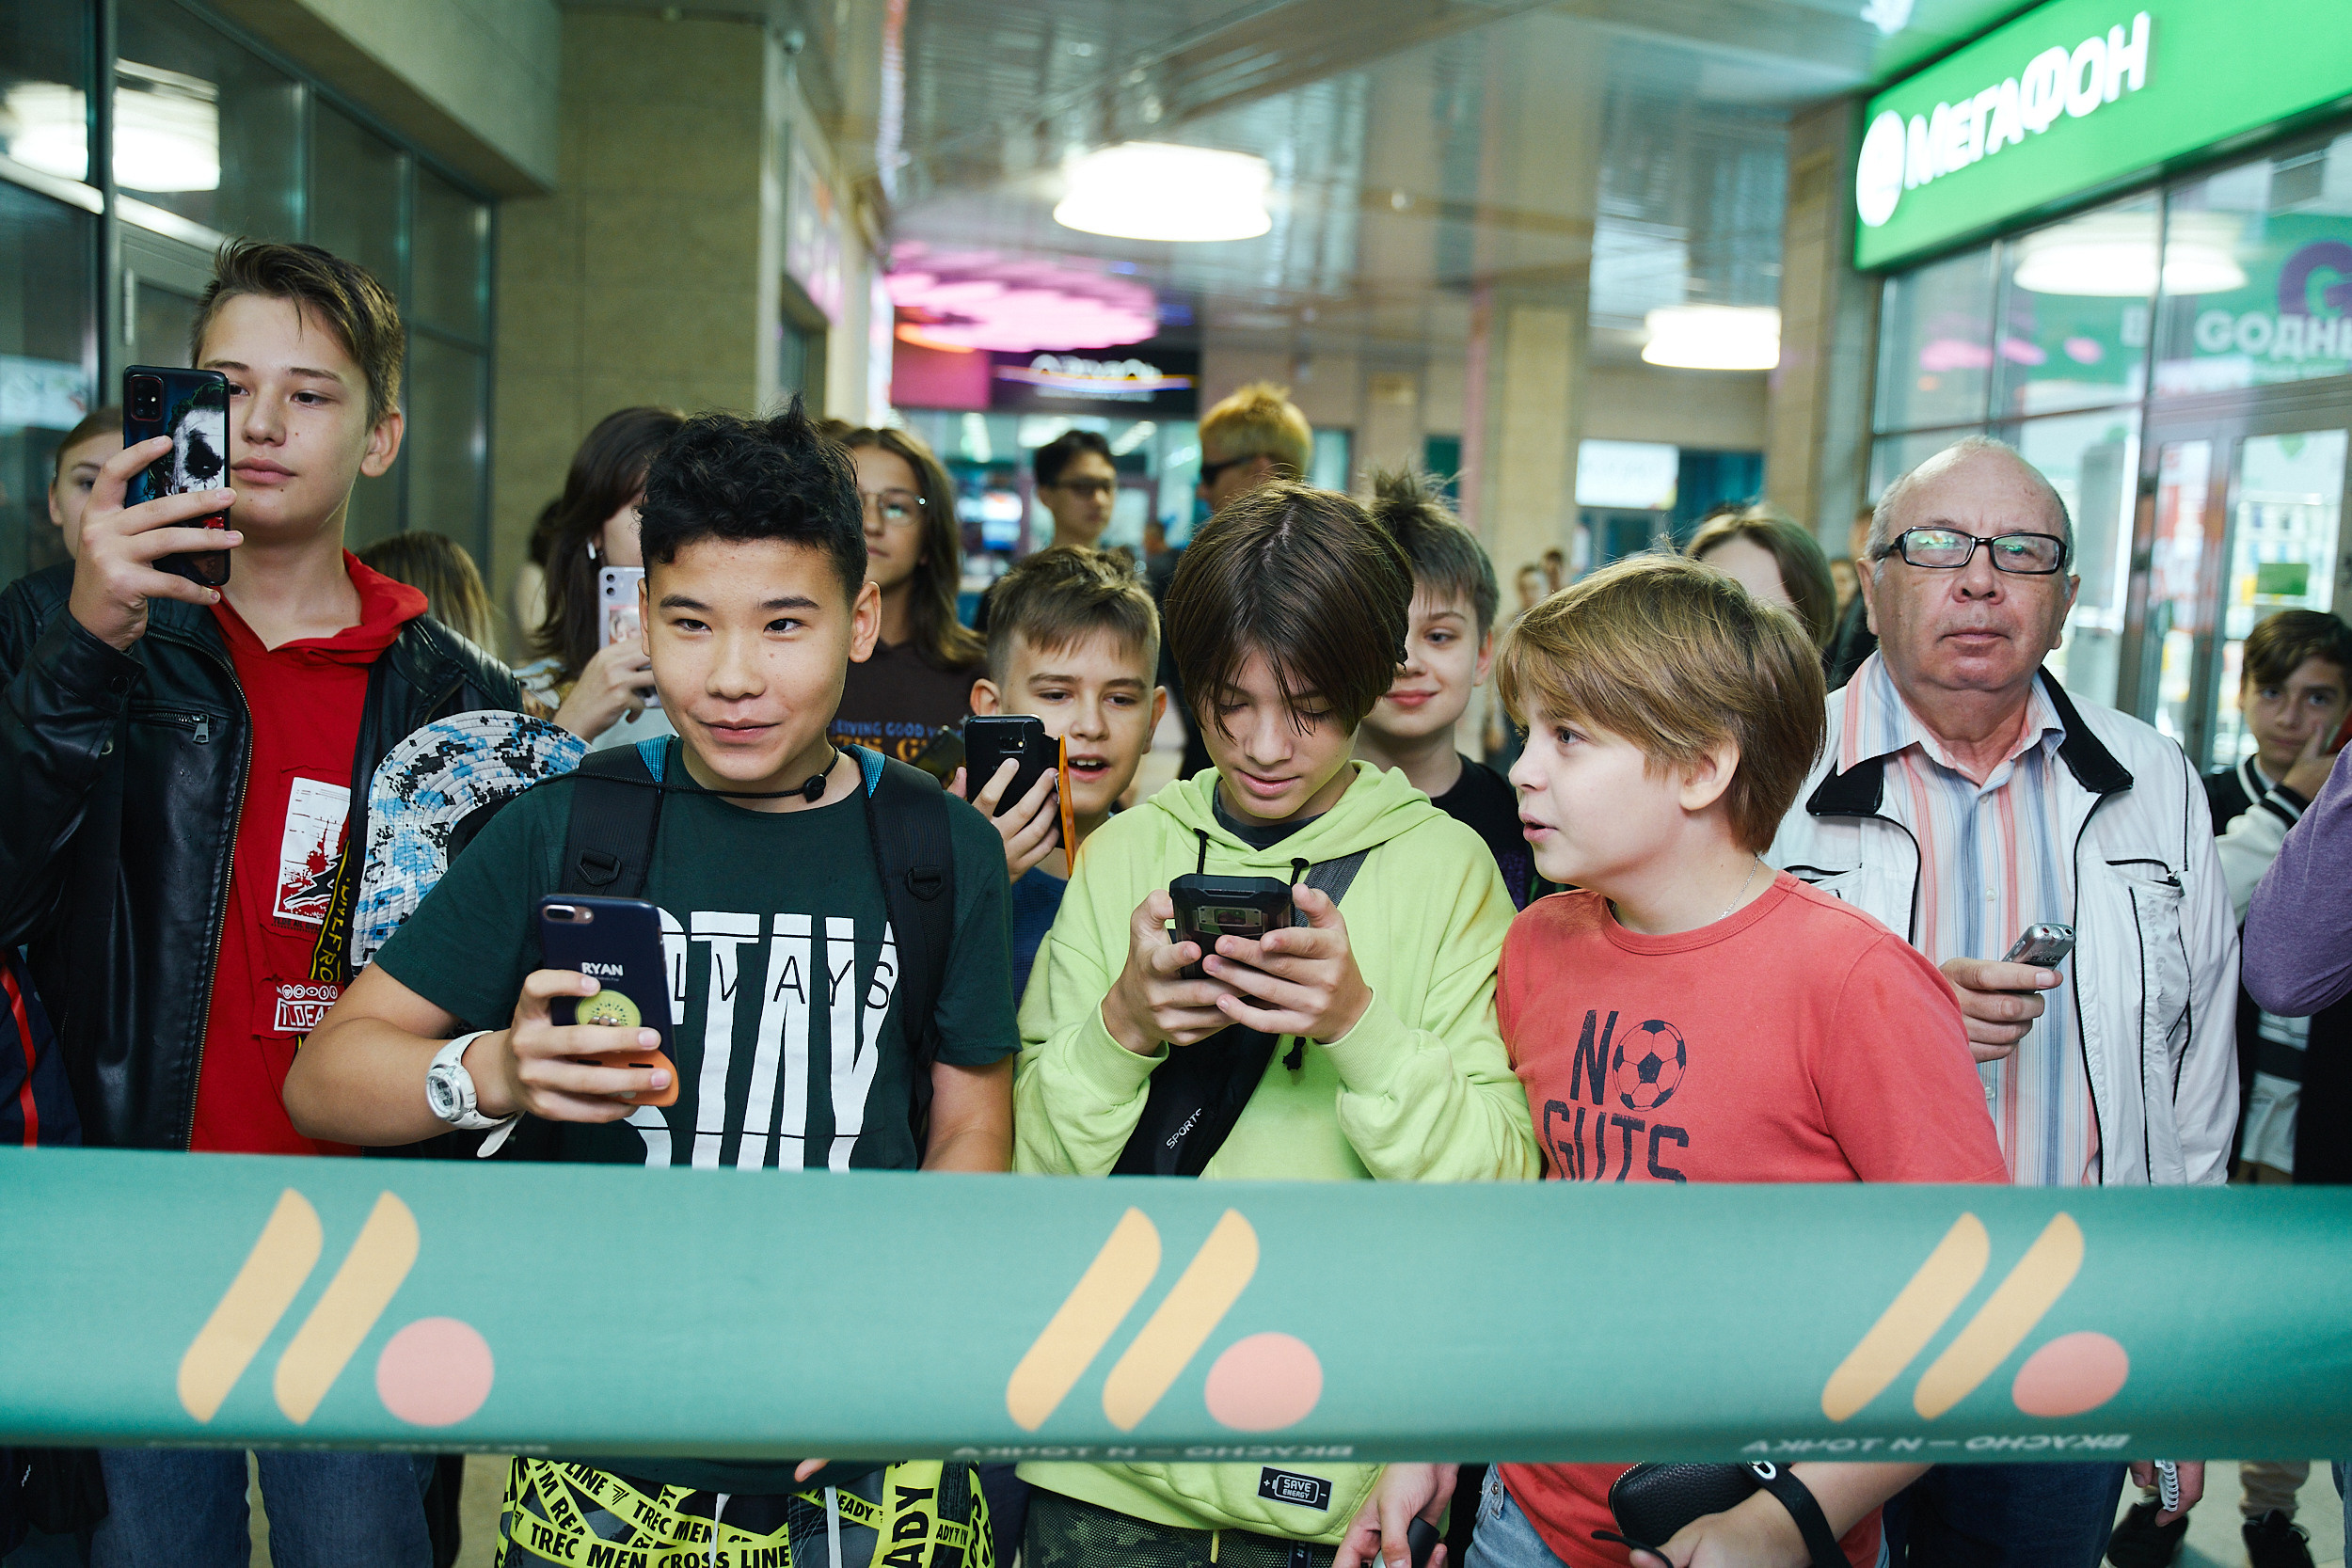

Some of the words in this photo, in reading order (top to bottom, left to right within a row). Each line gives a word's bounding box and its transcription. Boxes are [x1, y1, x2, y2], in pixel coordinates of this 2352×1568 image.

[1904, 10, 2151, 190] МЕГАФОН
[581, 961, 624, 976] RYAN
[625, 906, 897, 1172] TAY
[1543, 1099, 1690, 1185] GUTS
[836, 1492, 874, 1522] EADY
[1282, 1488, 1311, 1499] ENERGY
[1283, 1479, 1312, 1494] SAVE
[631, 1498, 673, 1535] TREC
[672, 1520, 721, 1544] MEN
[530, 1522, 580, 1560] TREC
[586, 1544, 648, 1568] MEN
[739, 1545, 790, 1568] LINE
